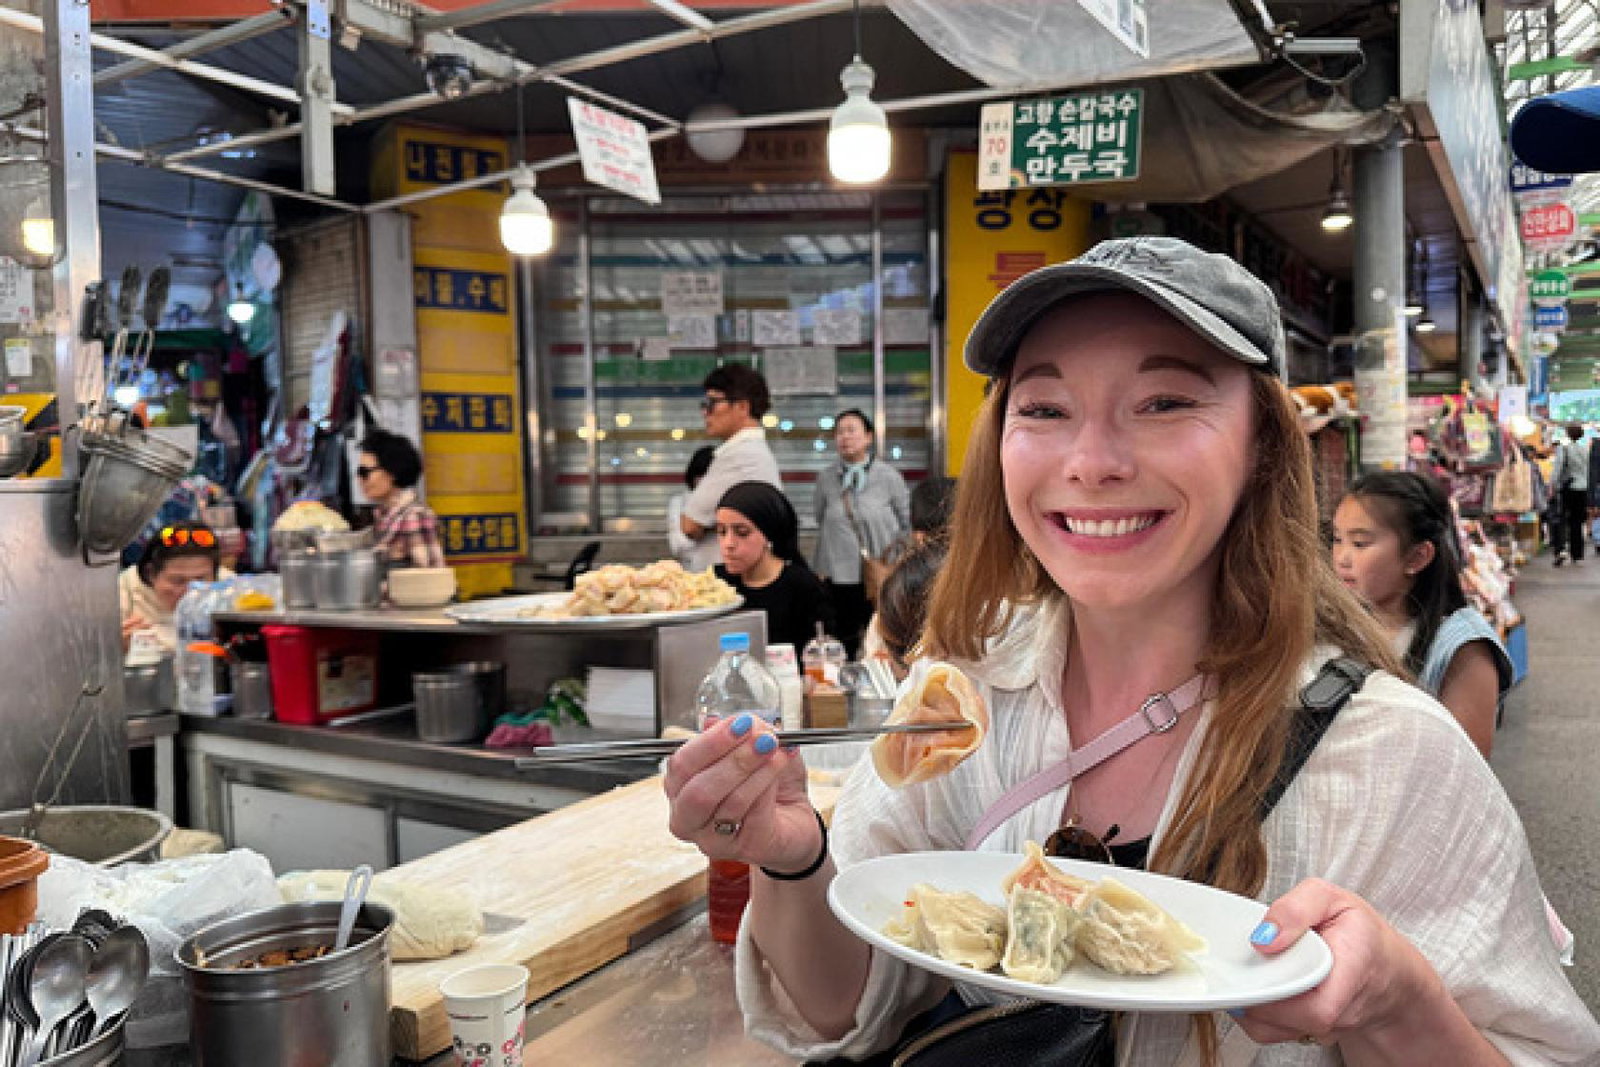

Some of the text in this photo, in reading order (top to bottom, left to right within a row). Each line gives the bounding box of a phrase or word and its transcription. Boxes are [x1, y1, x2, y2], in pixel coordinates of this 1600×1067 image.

[1058, 93, 1137, 124] 손칼국수
[985, 137, 1006, 156] 70
[1026, 119, 1128, 156] 수제비
[1026, 150, 1129, 183] 만두국
